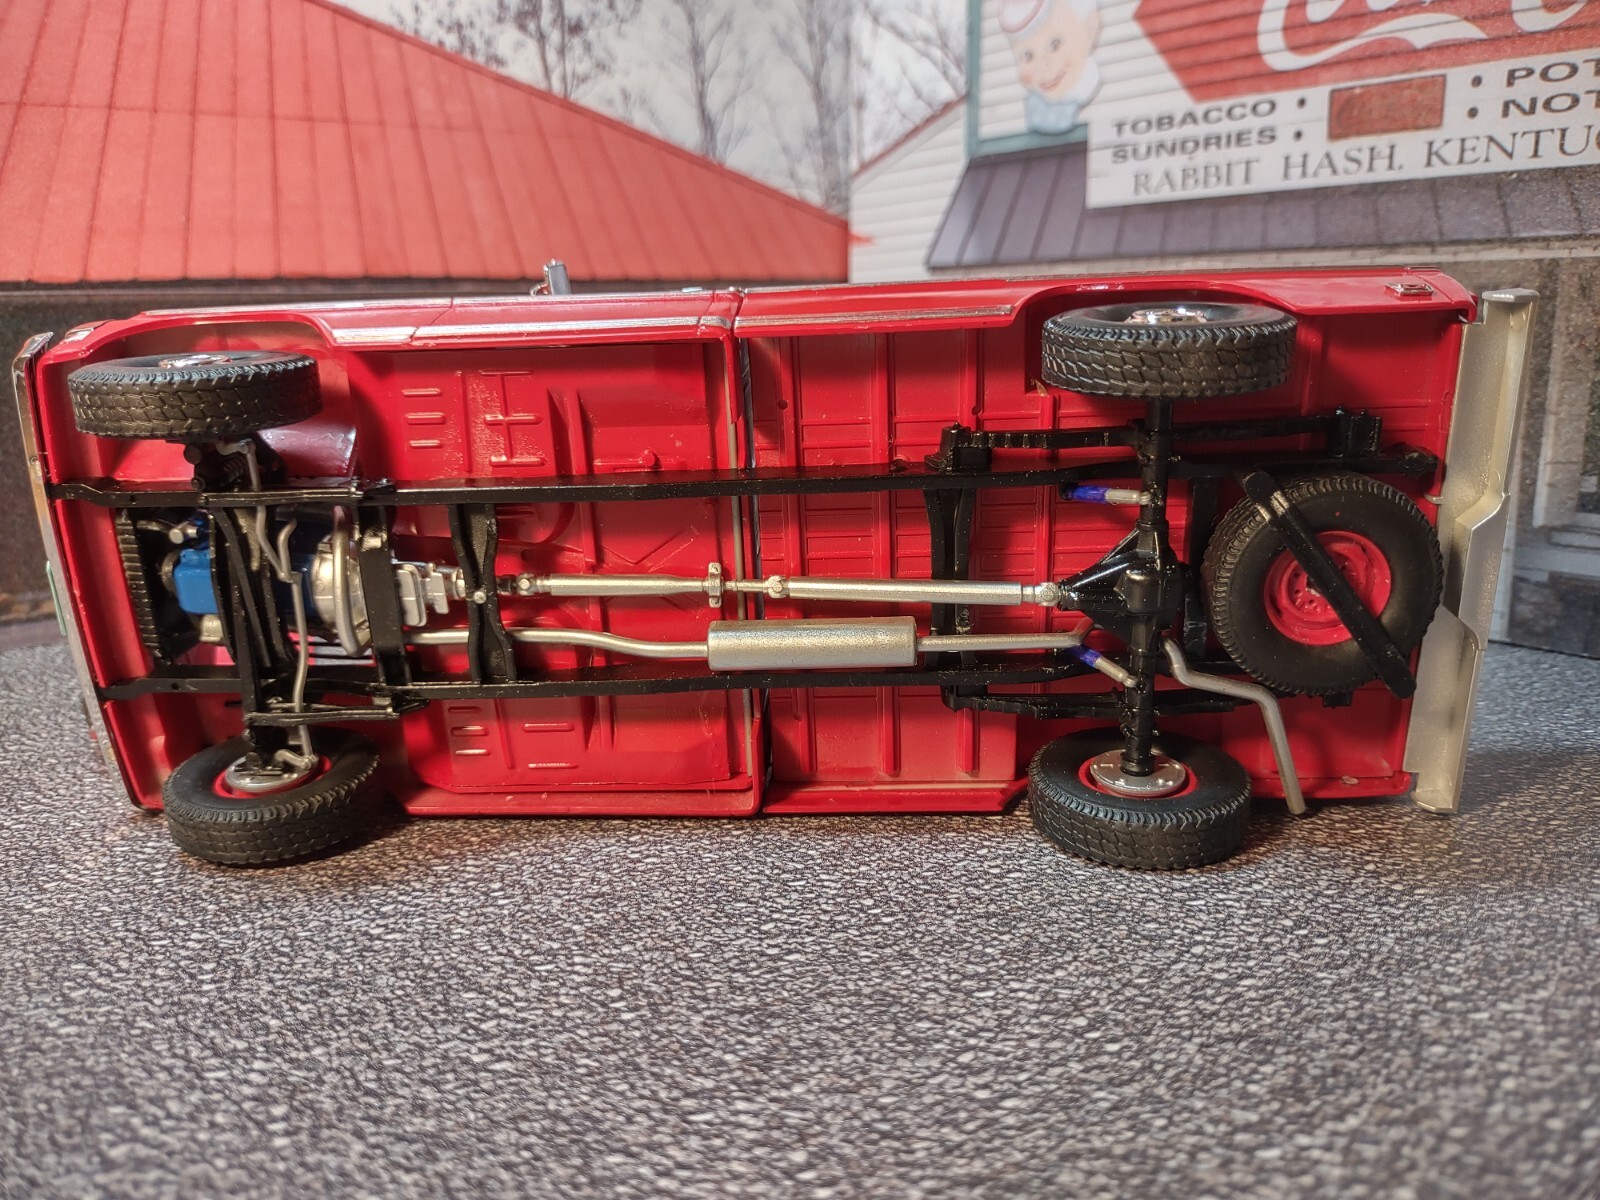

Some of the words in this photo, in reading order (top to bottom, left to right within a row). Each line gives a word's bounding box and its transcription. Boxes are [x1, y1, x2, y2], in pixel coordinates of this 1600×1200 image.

[1113, 99, 1277, 137] TOBACCO
[1111, 126, 1277, 164] SUNDRIES
[1133, 158, 1261, 196] RABBIT
[1424, 124, 1600, 169] KENTU
